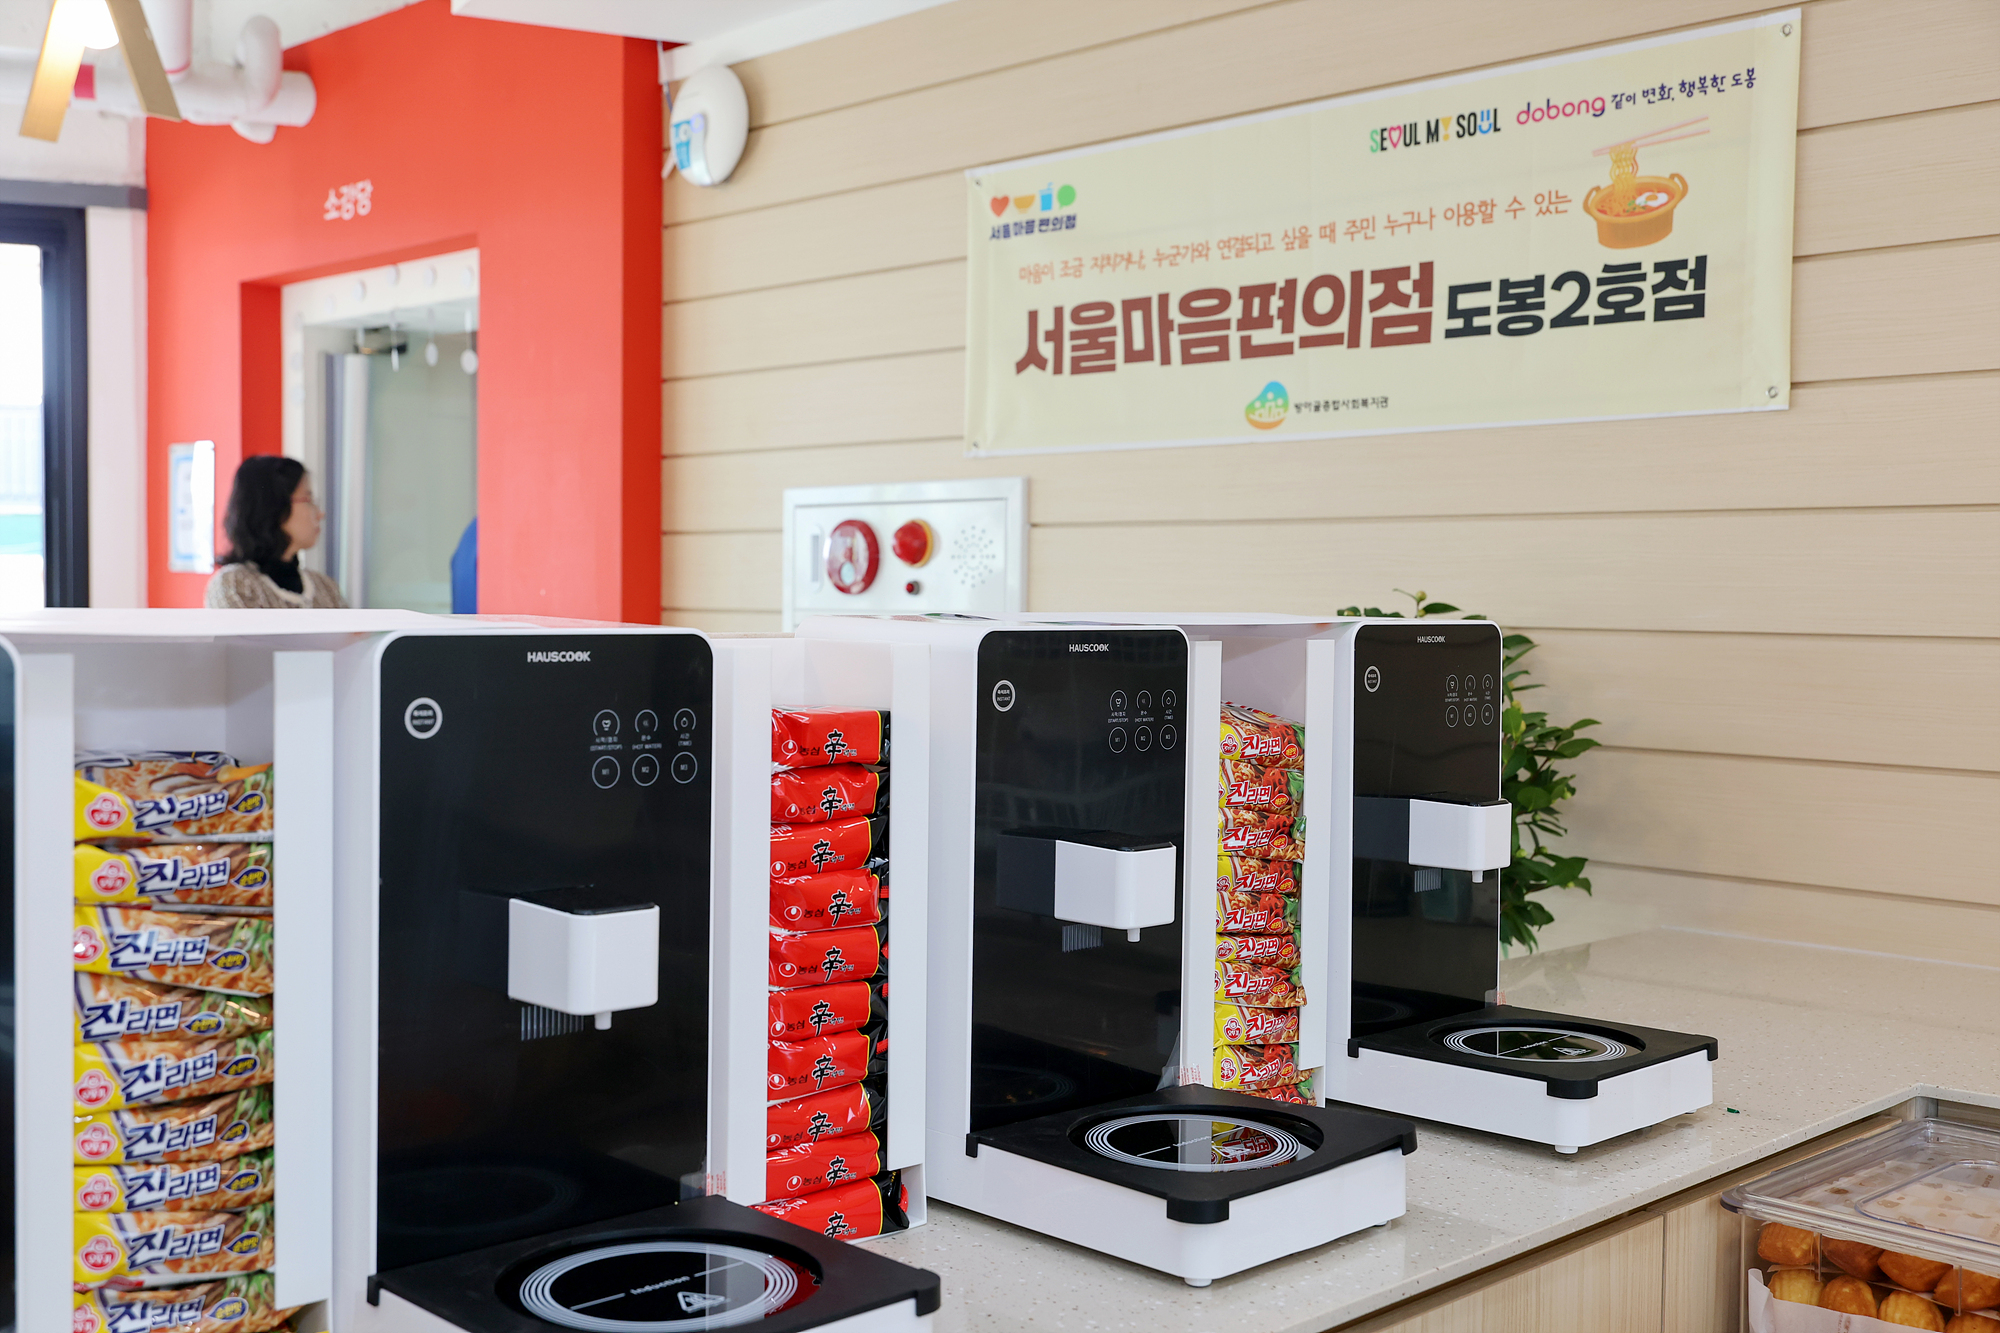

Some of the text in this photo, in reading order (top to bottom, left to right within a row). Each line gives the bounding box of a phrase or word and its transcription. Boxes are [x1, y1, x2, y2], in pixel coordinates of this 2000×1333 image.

[1611, 68, 1757, 110] 같이 변화, 행복한 도봉
[1516, 96, 1606, 125] dobong
[323, 179, 374, 220] 소강당
[1019, 262, 1054, 285] 마음이
[1060, 257, 1084, 279] 조금
[1153, 240, 1211, 268] 누군가와
[1217, 231, 1275, 261] 연결되고
[1281, 225, 1312, 251] 싶을
[1319, 221, 1336, 244] 때
[1343, 215, 1376, 242] 주민
[1384, 207, 1436, 237] 누구나
[1443, 198, 1497, 227] 이용할
[1505, 196, 1526, 220] 수
[1534, 190, 1572, 217] 있는
[1015, 254, 1708, 376] 서울마음편의점 도봉2호점
[1069, 643, 1110, 653] HAUSCOOK
[1417, 635, 1446, 644] HAUSCOOK
[527, 651, 591, 663] HAUSCOOK
[799, 745, 820, 756] 농심
[1240, 734, 1282, 759] 진라면
[1225, 780, 1271, 807] 진라면
[134, 790, 229, 832] 진라면
[1222, 825, 1274, 851] 진라면
[137, 857, 230, 896] 진라면
[787, 860, 807, 871] 농심
[803, 908, 824, 918] 농심
[1222, 907, 1268, 932] 진라면
[108, 931, 210, 971] 진라면
[1235, 937, 1279, 960] 진라면
[798, 965, 817, 974] 농심
[1224, 972, 1274, 998] 진라면
[81, 997, 182, 1042] 진라면
[787, 1020, 805, 1032] 농심
[121, 1050, 217, 1104] 진라면
[787, 1074, 808, 1086] 농심
[123, 1114, 217, 1162] 진라면
[783, 1132, 803, 1143] 농심
[124, 1163, 220, 1210] 진라면
[803, 1176, 822, 1186] 농심
[127, 1225, 225, 1271] 진라면
